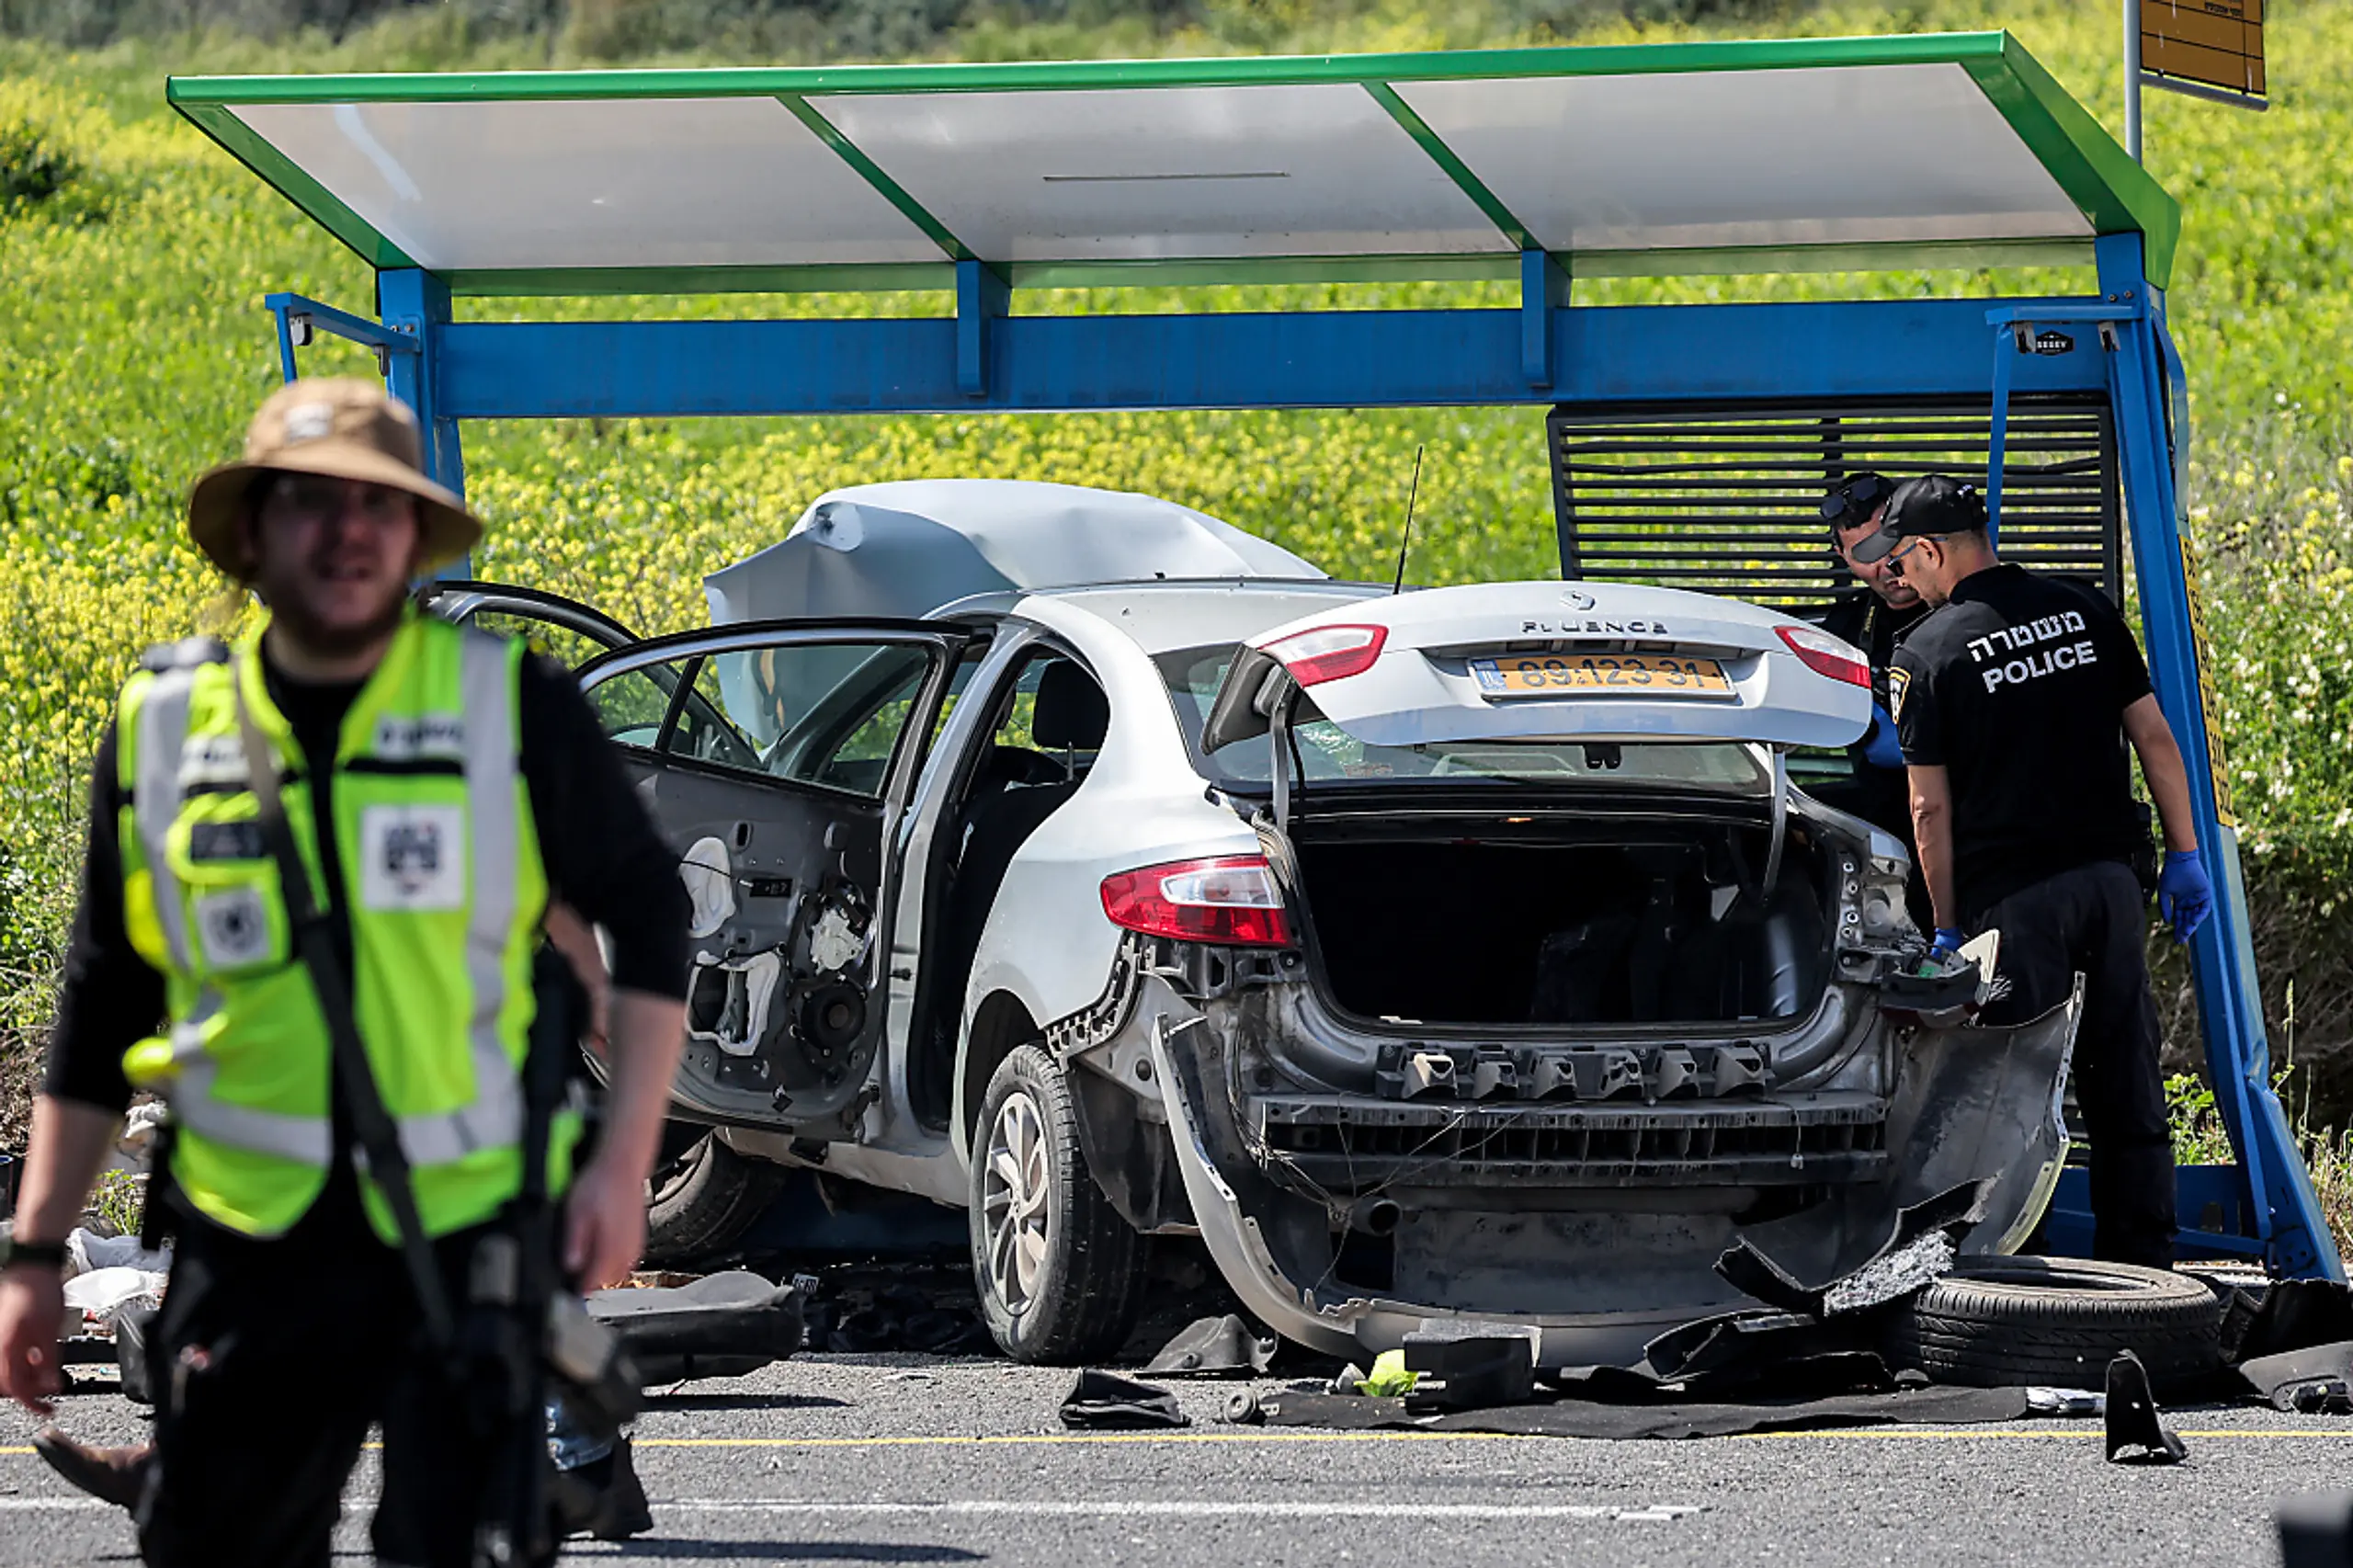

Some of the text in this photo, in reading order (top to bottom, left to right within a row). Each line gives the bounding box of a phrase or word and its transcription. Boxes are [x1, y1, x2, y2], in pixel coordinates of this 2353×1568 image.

[1520, 619, 1668, 634] FLUENCE
[1966, 610, 2086, 662] משטרה
[1982, 640, 2097, 693] POLICE
